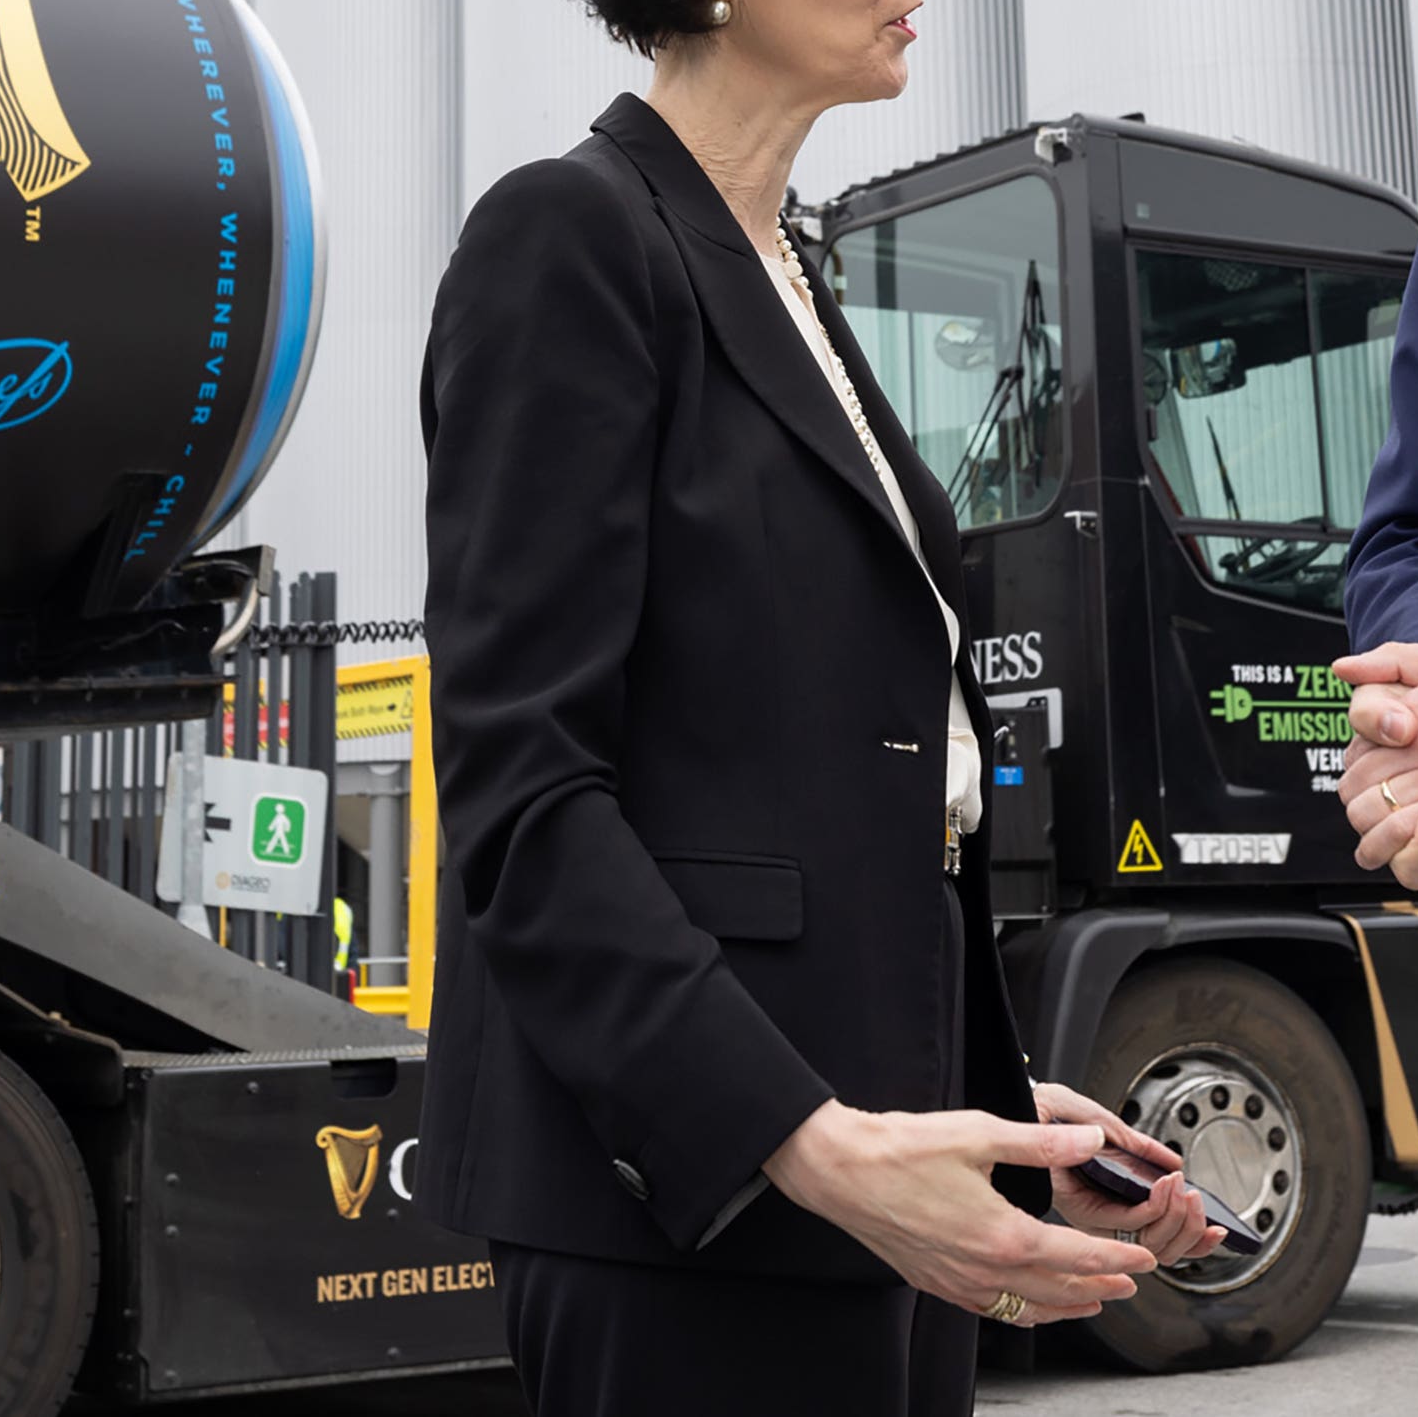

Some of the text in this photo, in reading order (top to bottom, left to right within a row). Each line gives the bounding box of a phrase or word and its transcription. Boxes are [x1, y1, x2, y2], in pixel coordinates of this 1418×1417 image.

[25, 205, 41, 242] TM
[190, 212, 238, 425] WHENEVER
[1231, 664, 1265, 684] THIS
[1267, 665, 1282, 684] IS
[1283, 666, 1294, 684] A
[317, 1272, 378, 1304] NEXT
[381, 1266, 428, 1297] GEN
